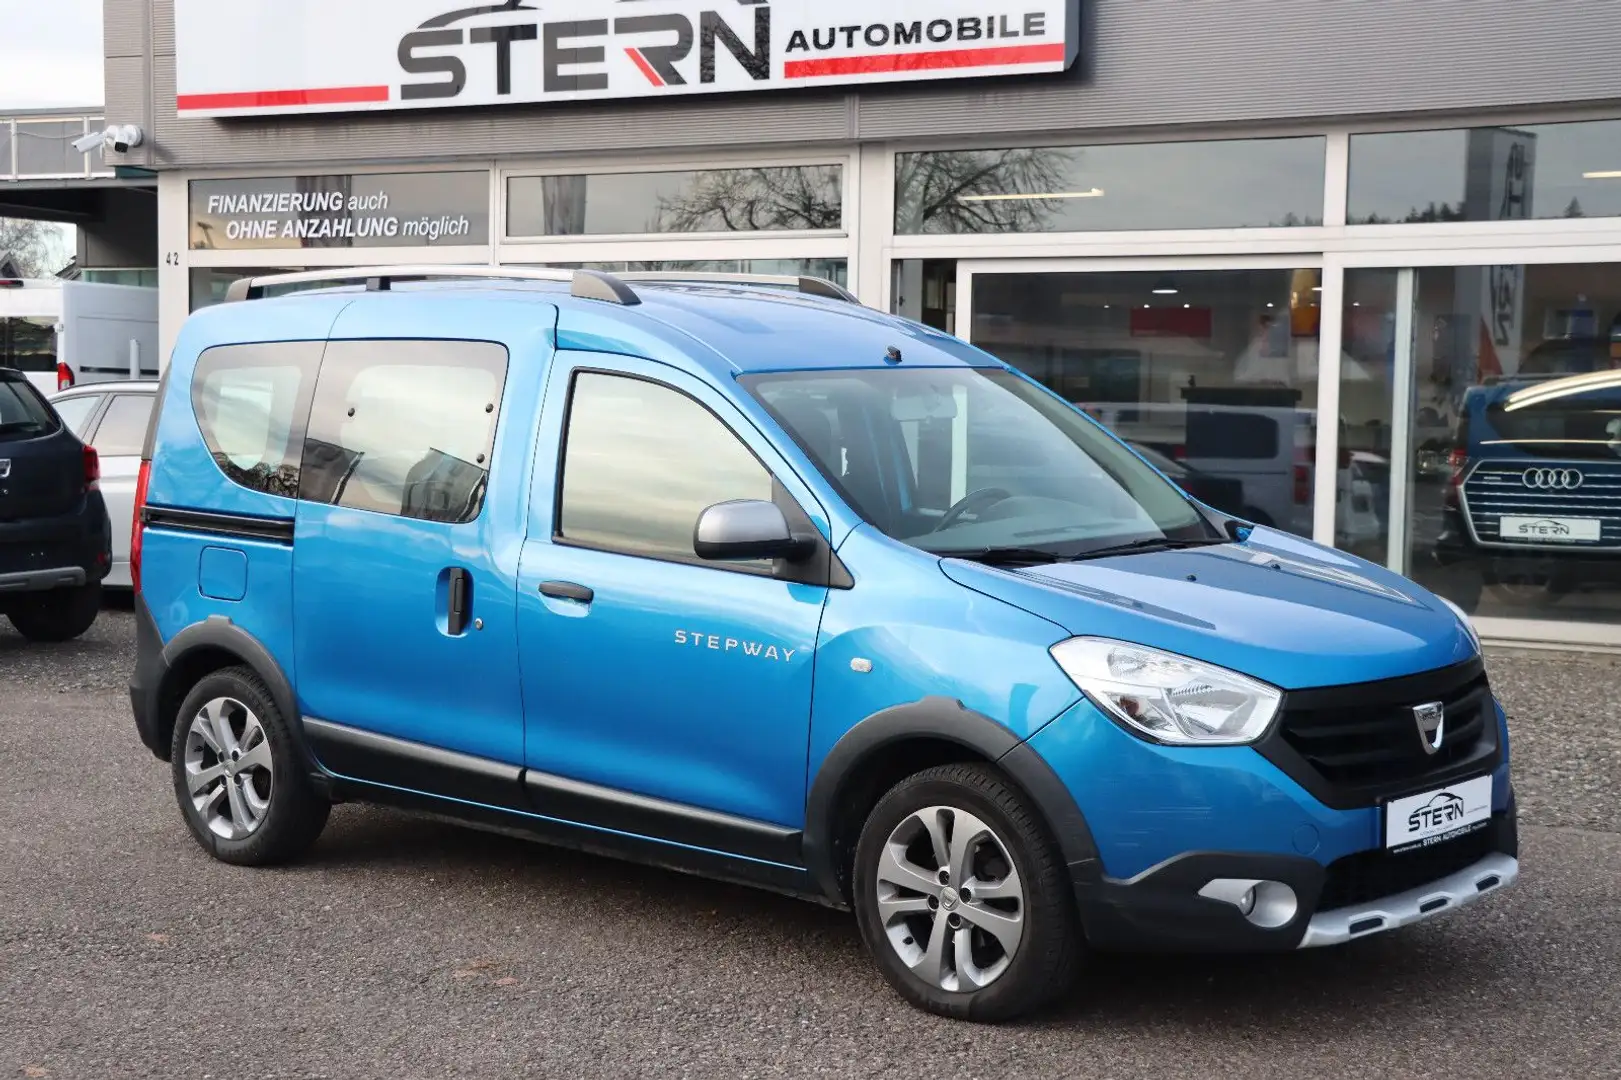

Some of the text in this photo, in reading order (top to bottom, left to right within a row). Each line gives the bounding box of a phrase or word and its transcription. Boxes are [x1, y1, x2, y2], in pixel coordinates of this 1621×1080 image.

[398, 5, 1046, 100] STERN AUTOMOBILE
[207, 190, 389, 214] FINANZIERUNG auch
[226, 215, 470, 241] OHNE ANZAHLUNG möglich
[1518, 525, 1570, 536] STERN
[674, 629, 796, 662] STEPWAY
[1408, 804, 1464, 832] STERN
[1422, 835, 1443, 847] STERN
